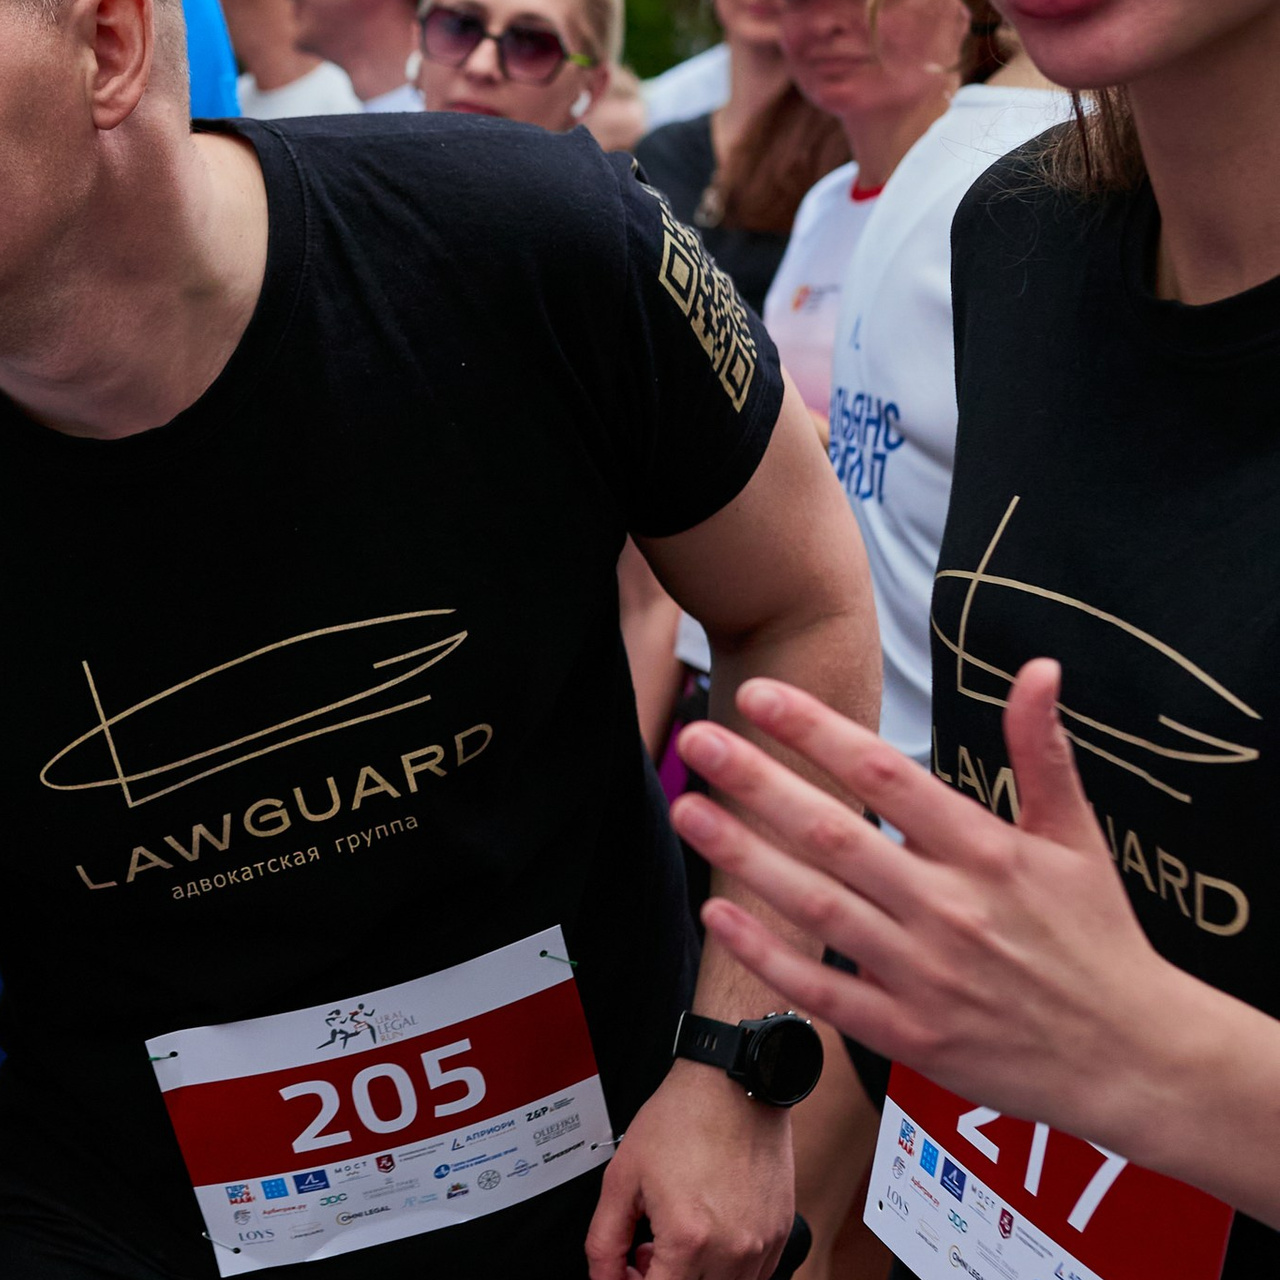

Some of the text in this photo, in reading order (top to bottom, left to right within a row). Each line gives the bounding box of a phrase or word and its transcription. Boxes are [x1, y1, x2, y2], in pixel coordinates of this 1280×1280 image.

[829, 387, 905, 451] ЛЬЯНС
[75, 723, 494, 890] LAWGUARD
[933, 725, 1250, 936] LAWARD
[171, 815, 419, 900] адвокатская группа
[278, 1037, 487, 1155] 205
[465, 1120, 516, 1143] АПРИОРИ
[334, 1161, 368, 1174] МОСТ
